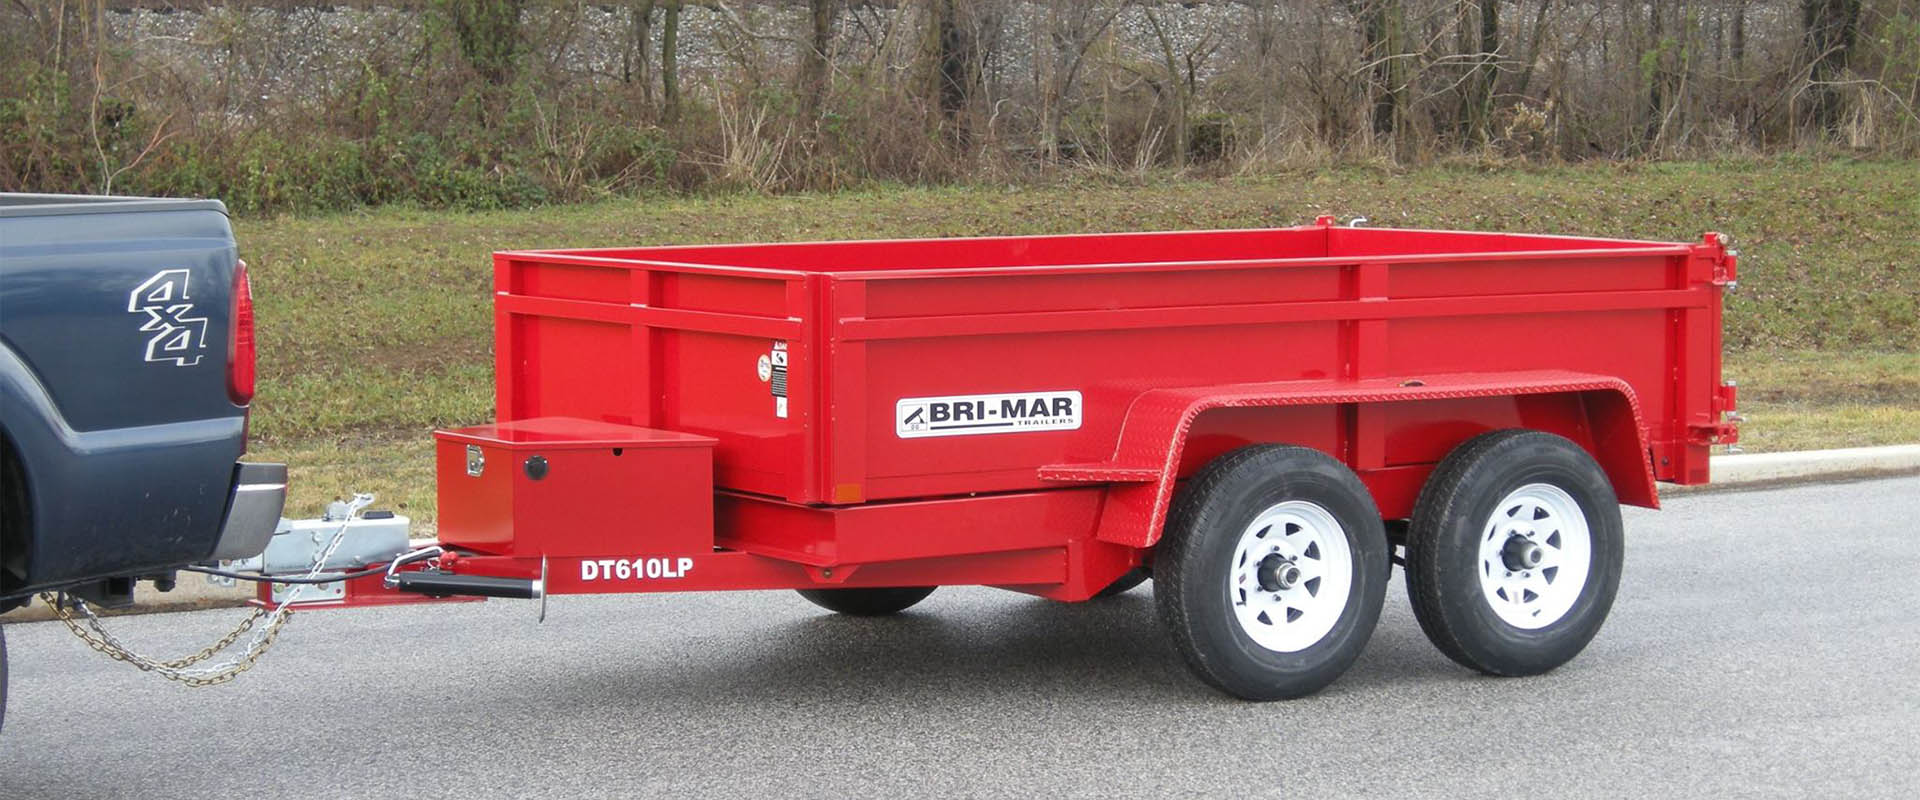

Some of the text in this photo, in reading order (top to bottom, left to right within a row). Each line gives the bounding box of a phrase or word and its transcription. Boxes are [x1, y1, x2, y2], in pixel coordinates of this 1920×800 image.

[930, 397, 1073, 422] BRI-MAR
[1018, 418, 1074, 426] TRAILERS
[581, 558, 694, 580] DT610LP
